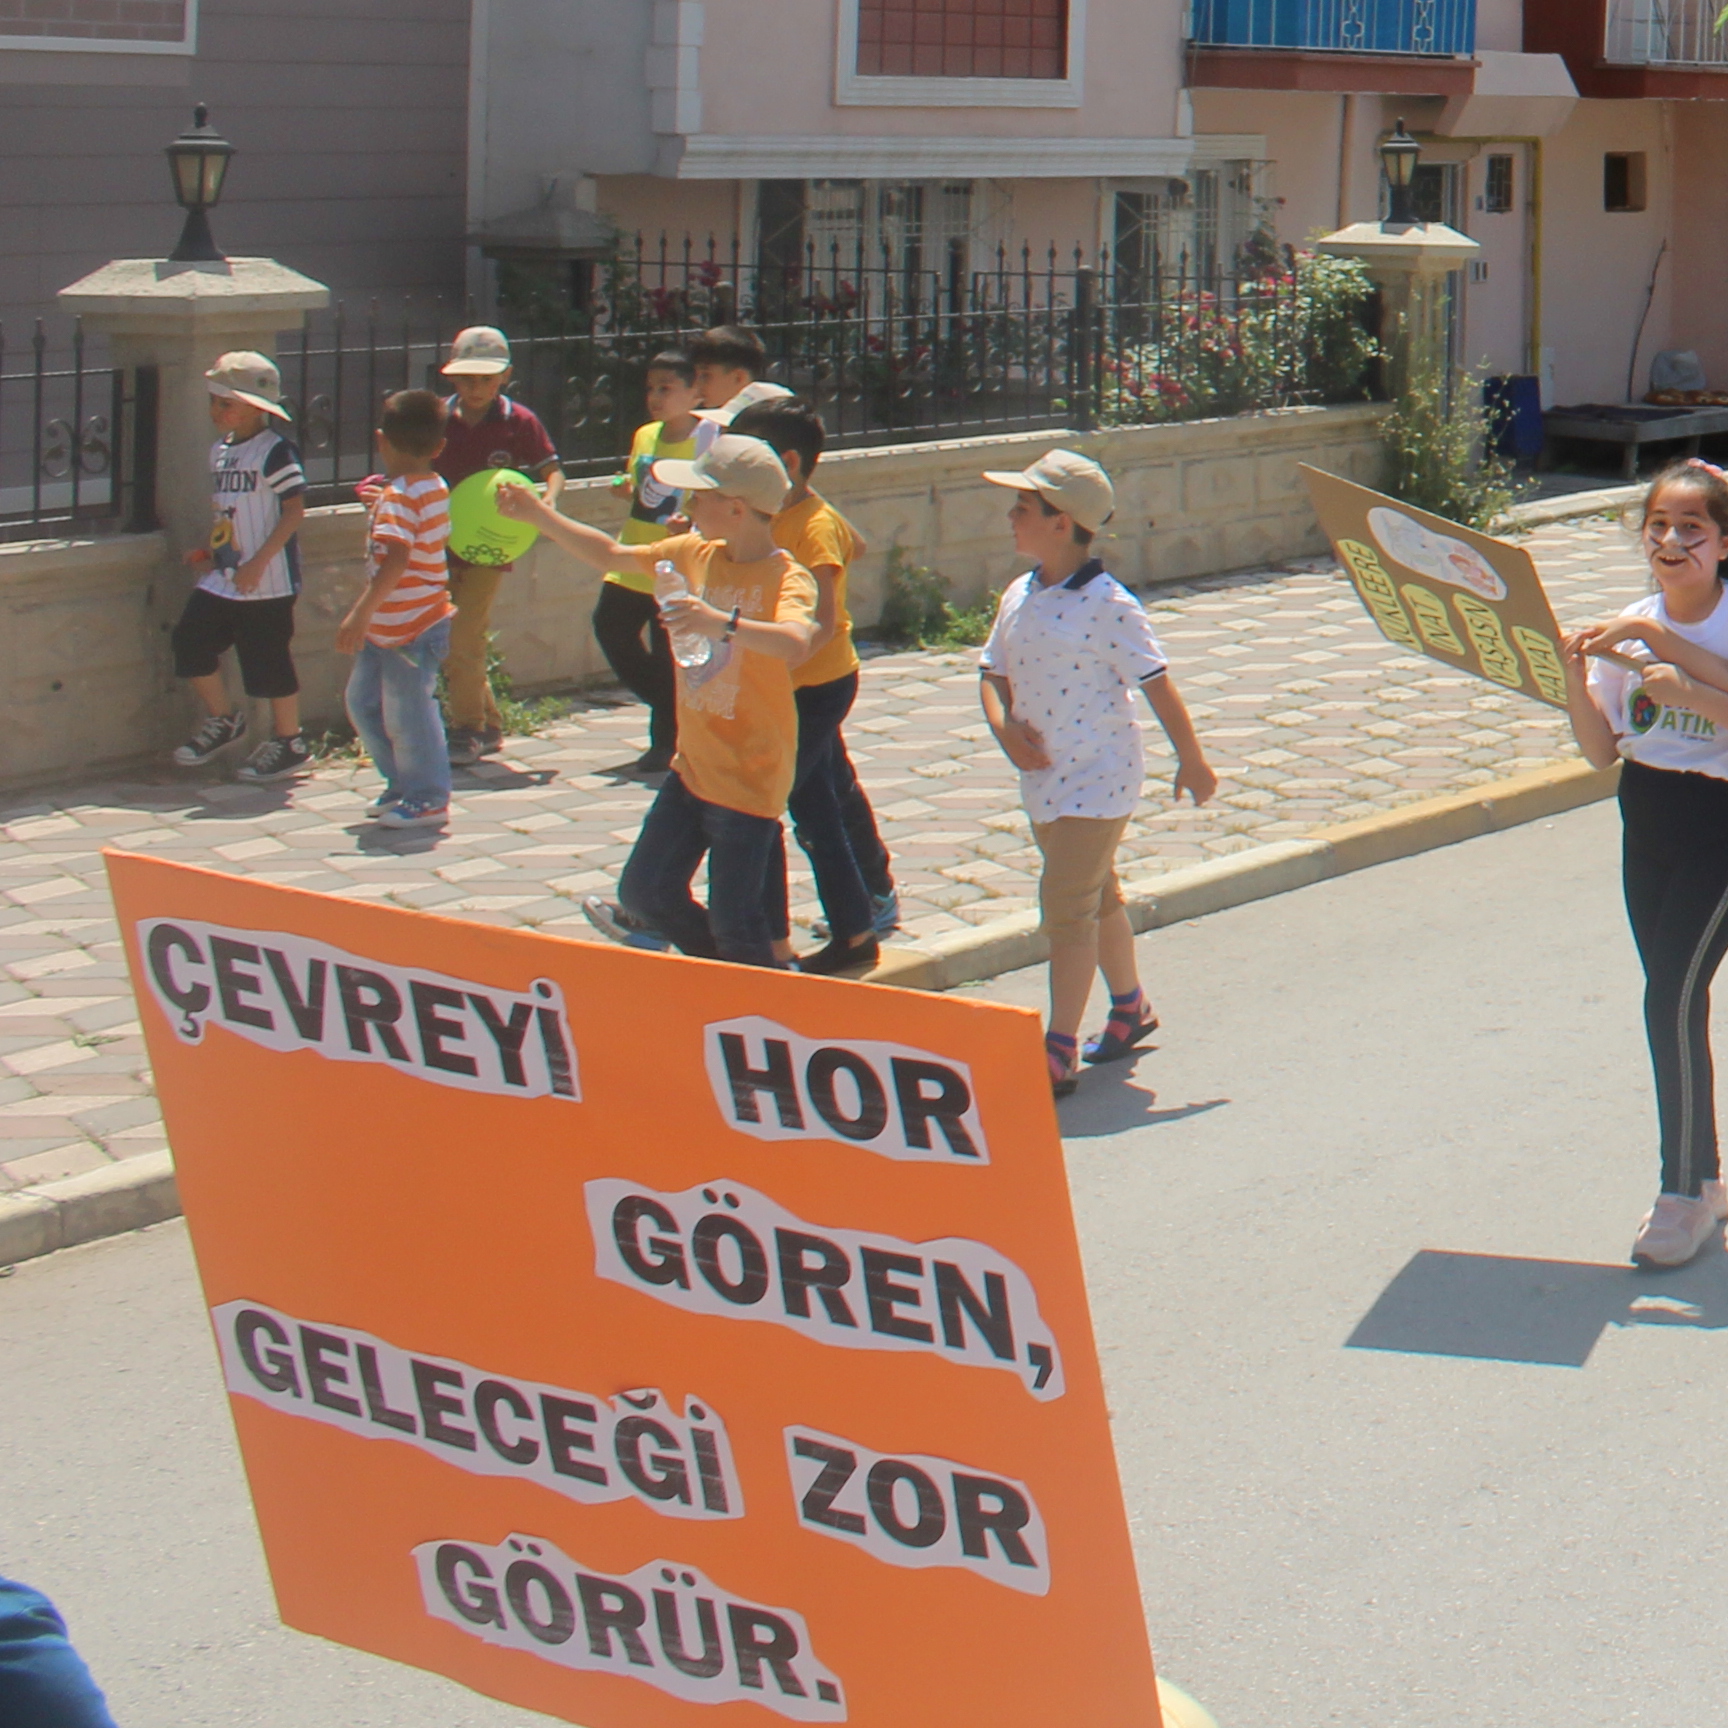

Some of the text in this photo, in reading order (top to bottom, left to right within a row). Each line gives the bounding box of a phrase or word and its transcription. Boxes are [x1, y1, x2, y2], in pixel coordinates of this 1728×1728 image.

[1520, 629, 1569, 703] HAYAT
[1660, 709, 1716, 736] ATIK
[146, 921, 983, 1159] ÇEVREYİ HOR
[610, 1186, 1055, 1391] GÖREN,
[232, 1306, 1040, 1569] GELECEĞİ ZOR
[431, 1540, 843, 1706] GÖRÜR.
